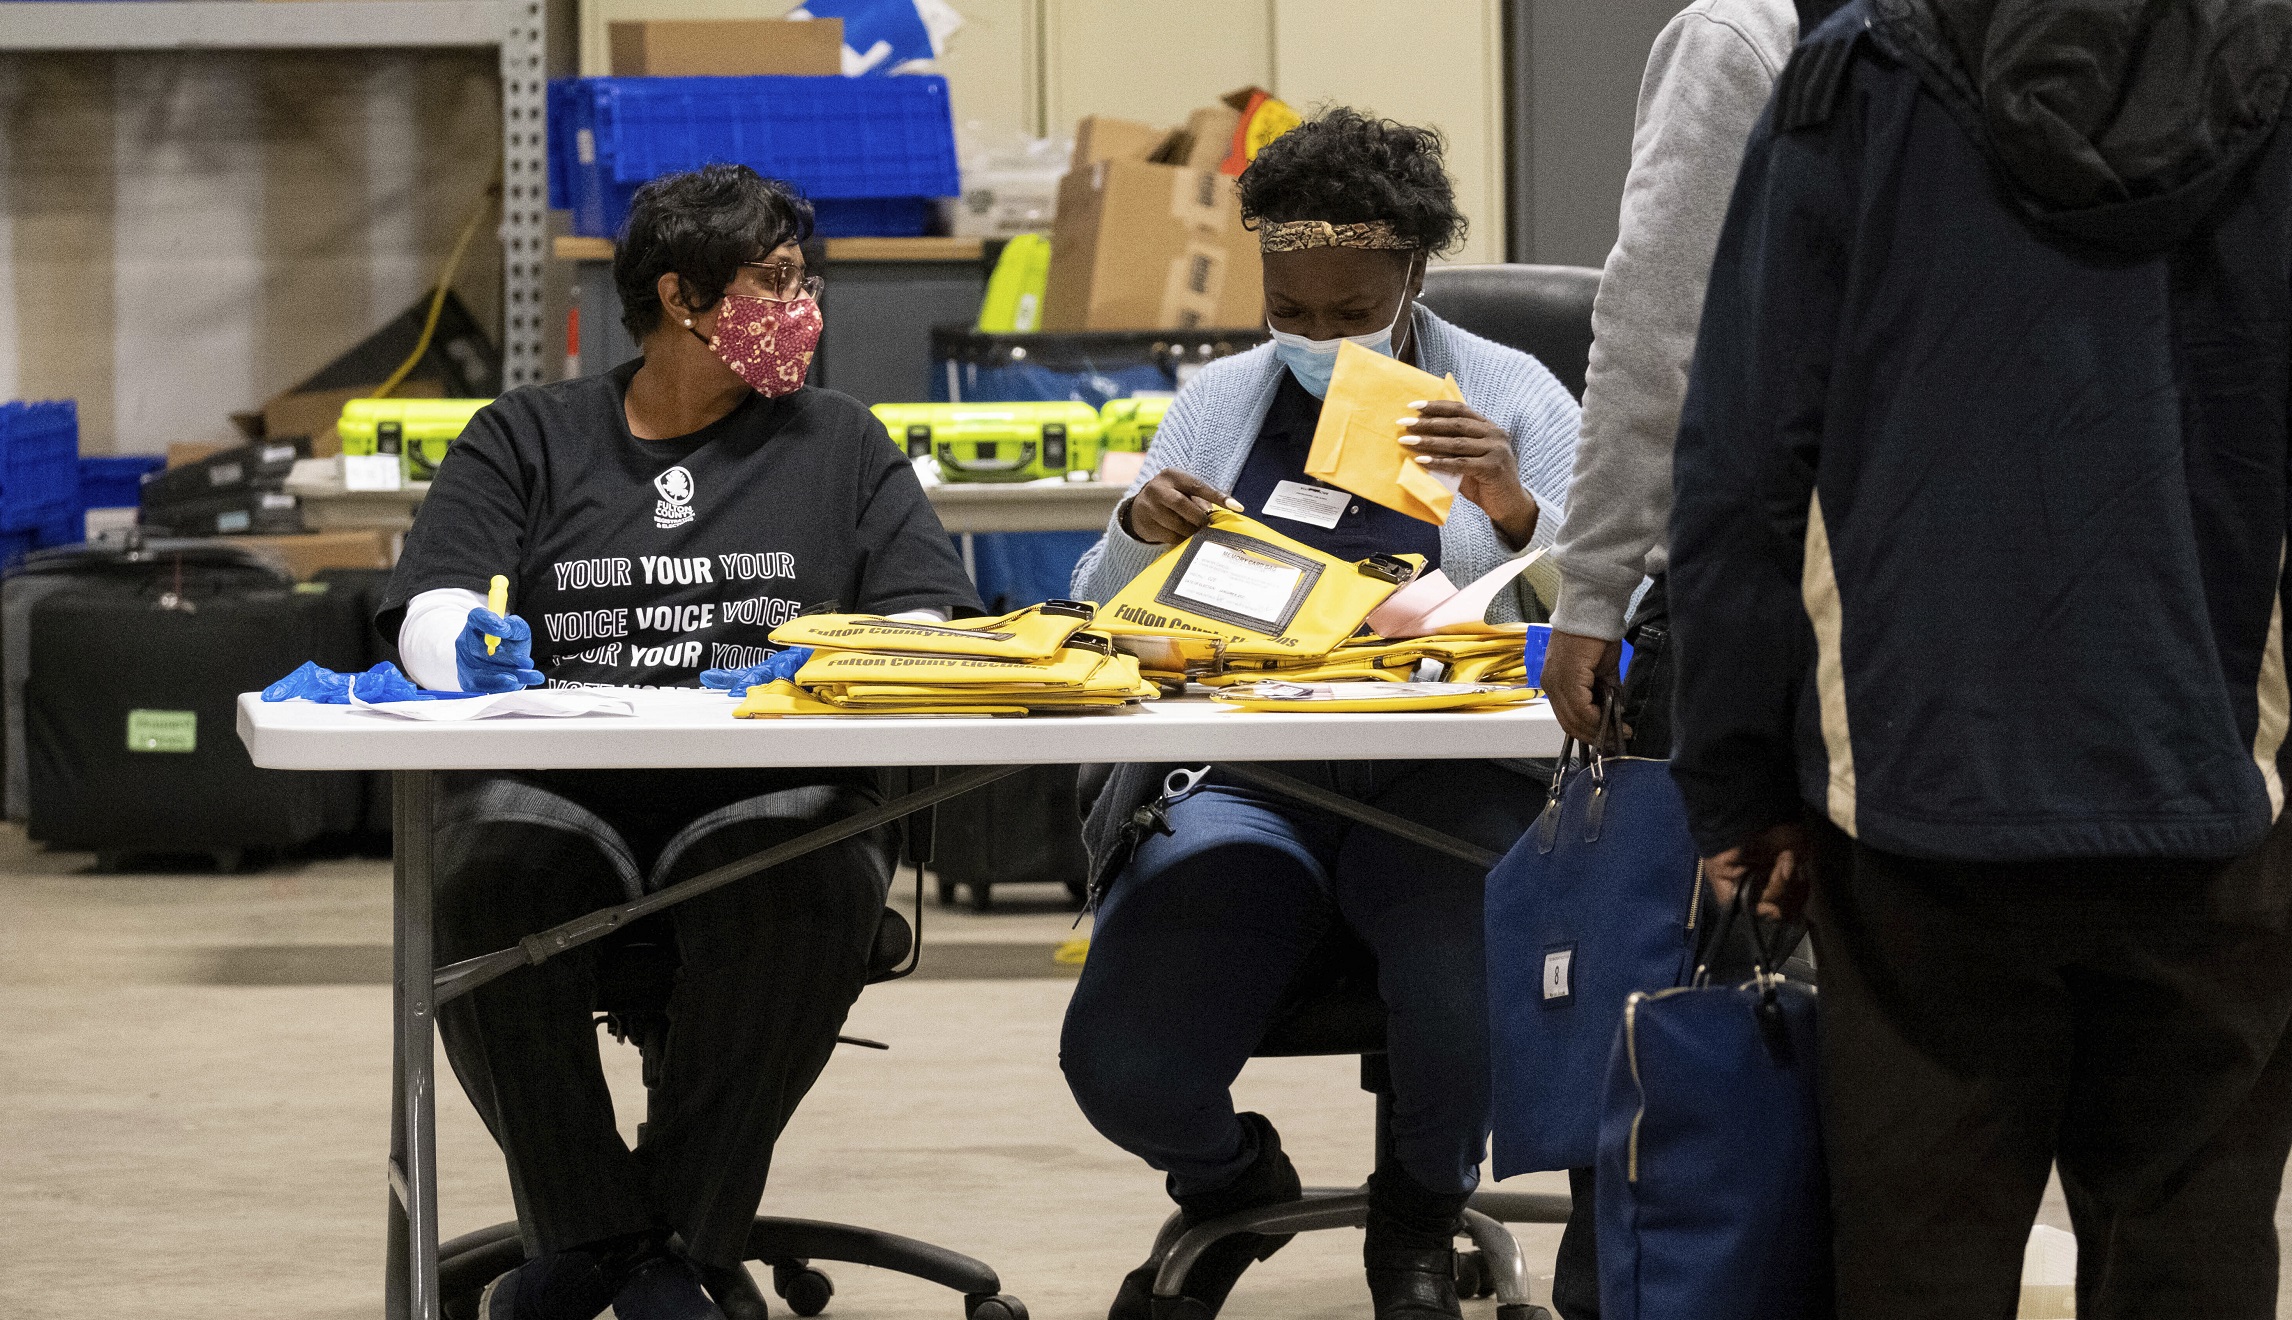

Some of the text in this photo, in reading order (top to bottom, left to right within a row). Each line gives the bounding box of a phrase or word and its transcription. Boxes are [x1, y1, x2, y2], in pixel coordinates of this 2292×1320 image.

[655, 507, 696, 518] COUNTY
[657, 500, 692, 513] FULTON
[554, 551, 796, 590] YOUR YOUR YOUR
[544, 596, 801, 642] VOICE VOICE VOICE
[1114, 603, 1167, 628] Fulton
[808, 627, 865, 637] Fulton
[868, 627, 935, 637] County
[630, 641, 703, 668] YOUR
[828, 658, 887, 667] Fulton
[890, 658, 957, 667] County
[1554, 965, 1559, 985] 8
